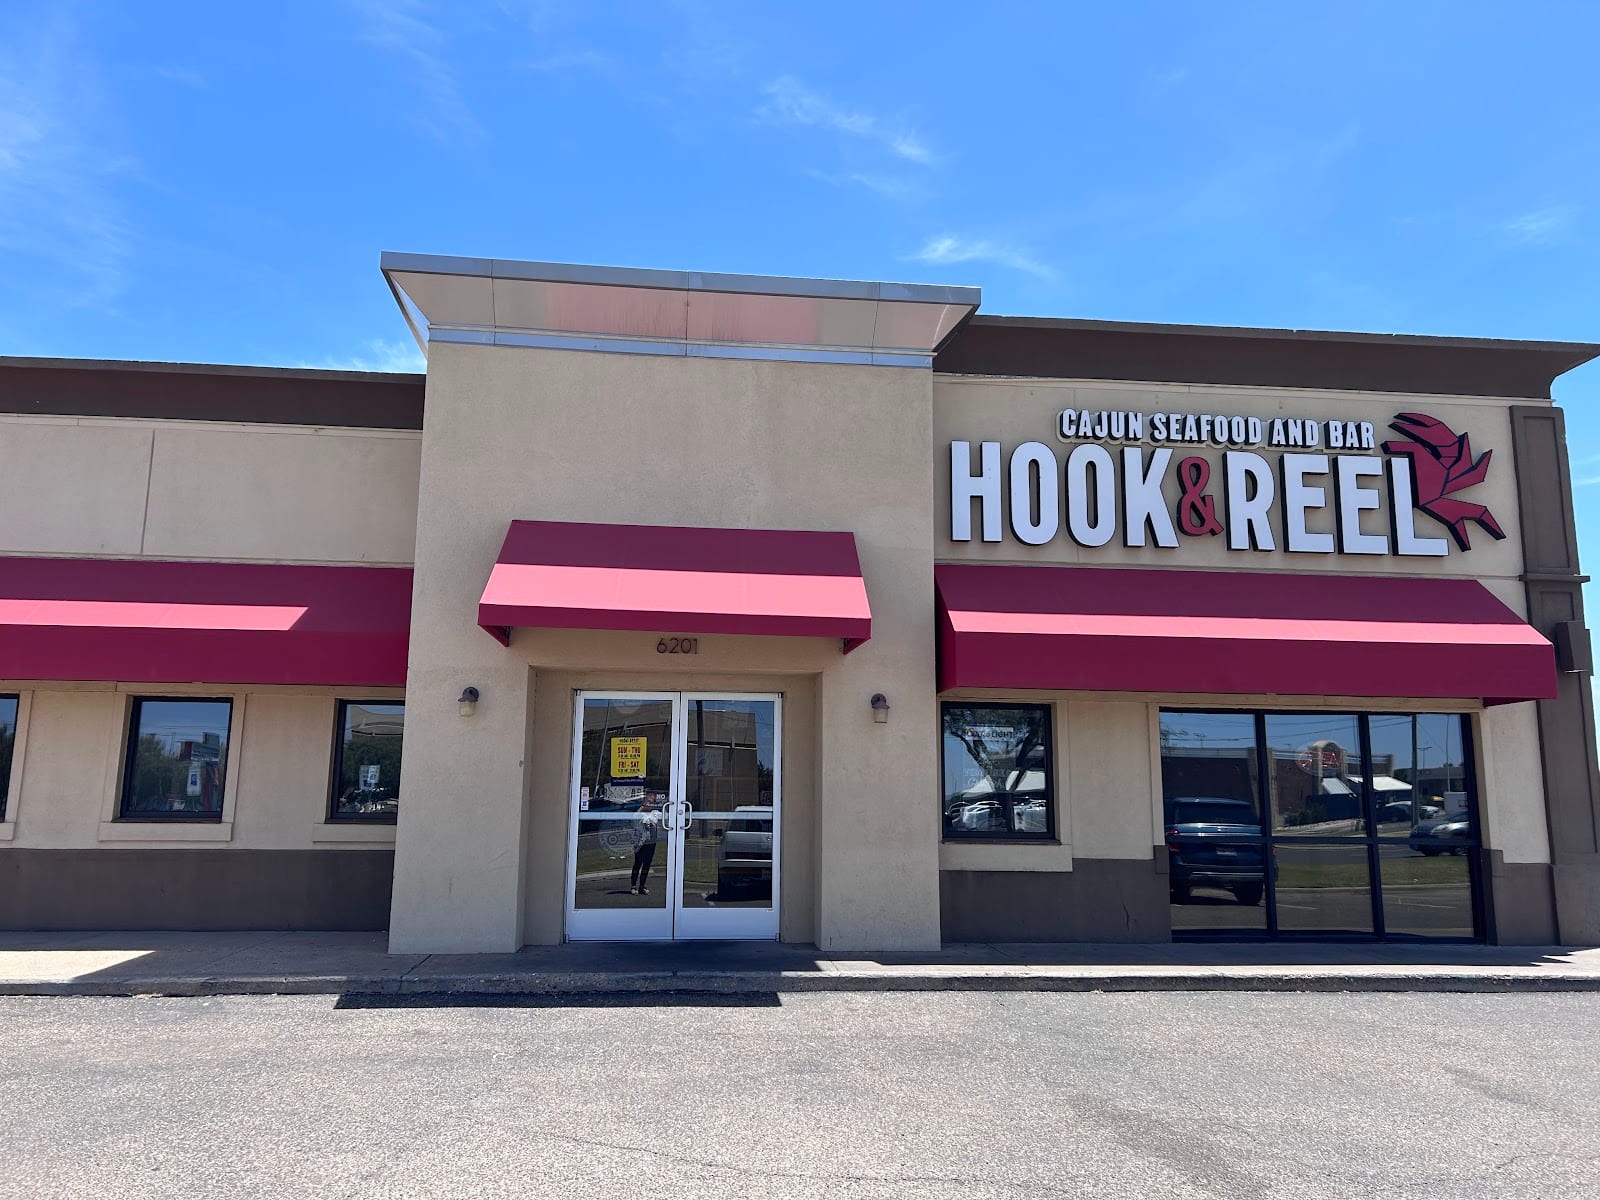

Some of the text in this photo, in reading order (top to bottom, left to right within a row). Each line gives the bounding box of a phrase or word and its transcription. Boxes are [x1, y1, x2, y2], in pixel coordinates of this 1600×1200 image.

[1060, 408, 1375, 450] CAJUN SEAFOOD AND BAR
[656, 637, 698, 655] 6201
